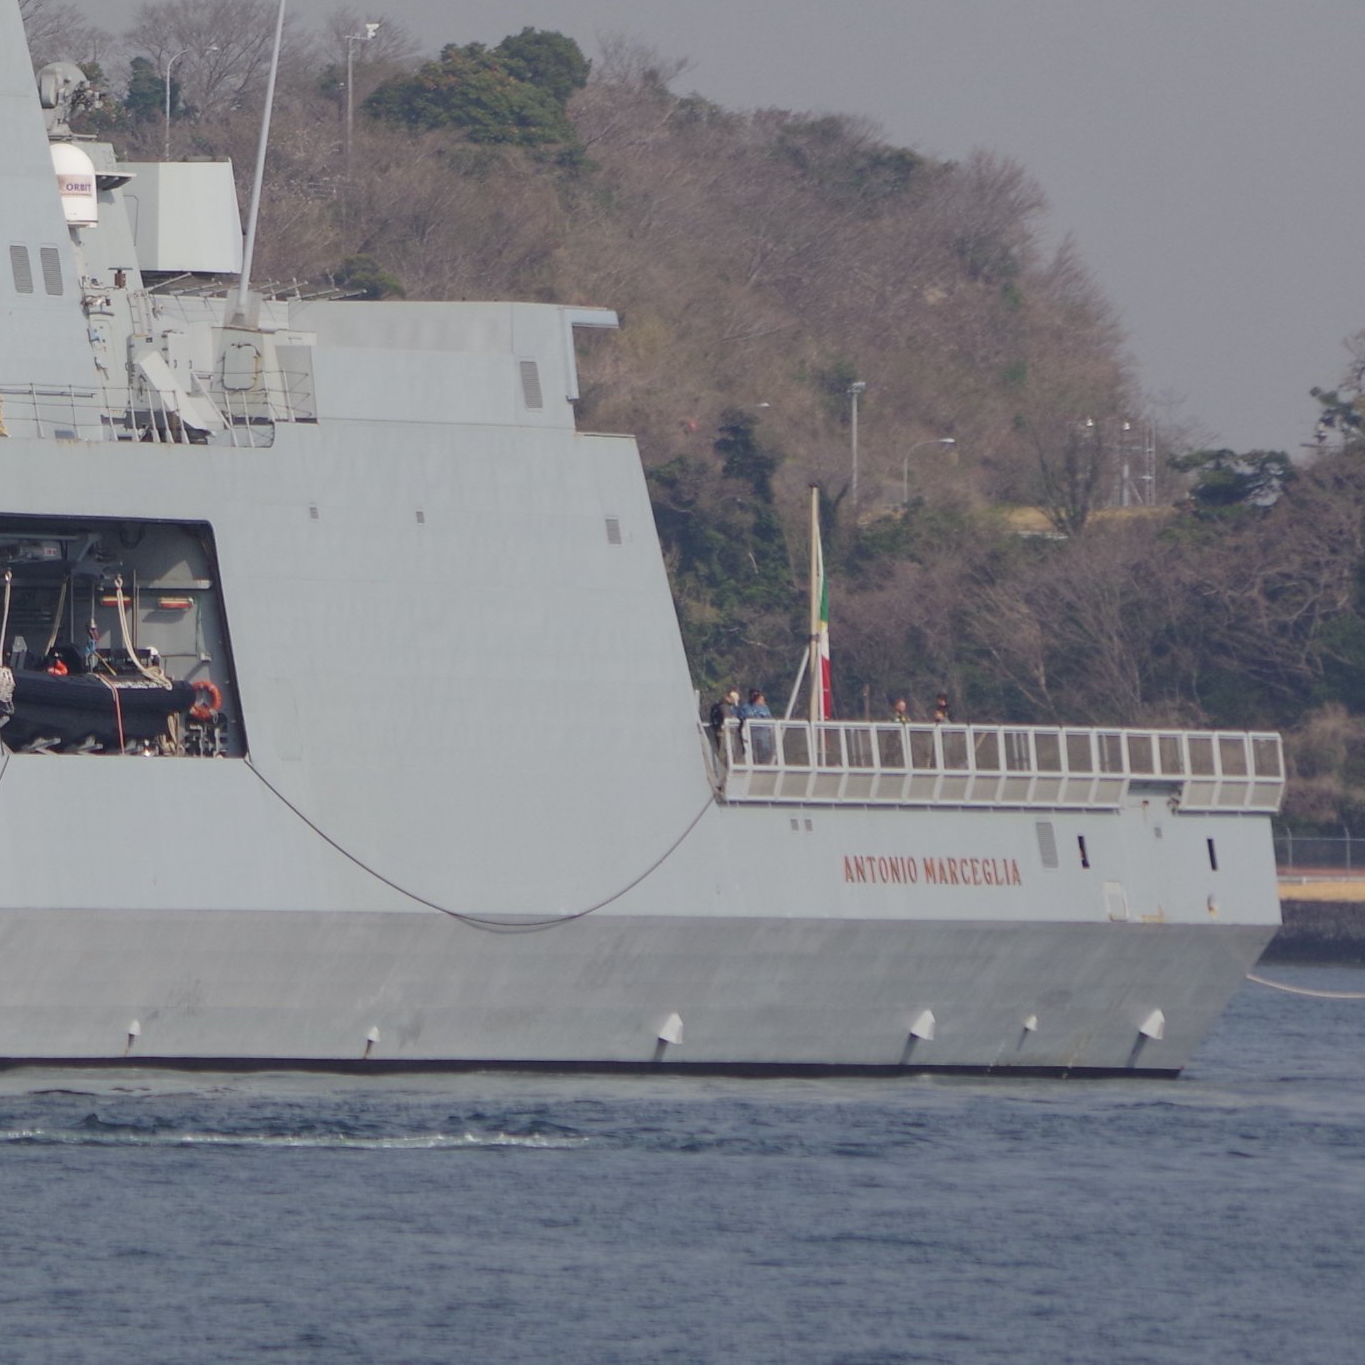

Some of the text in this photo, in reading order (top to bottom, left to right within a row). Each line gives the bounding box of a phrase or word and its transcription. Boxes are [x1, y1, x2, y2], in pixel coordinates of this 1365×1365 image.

[65, 183, 92, 192] ORBIT
[843, 855, 1022, 886] ANTONIO MARCEGLIA
